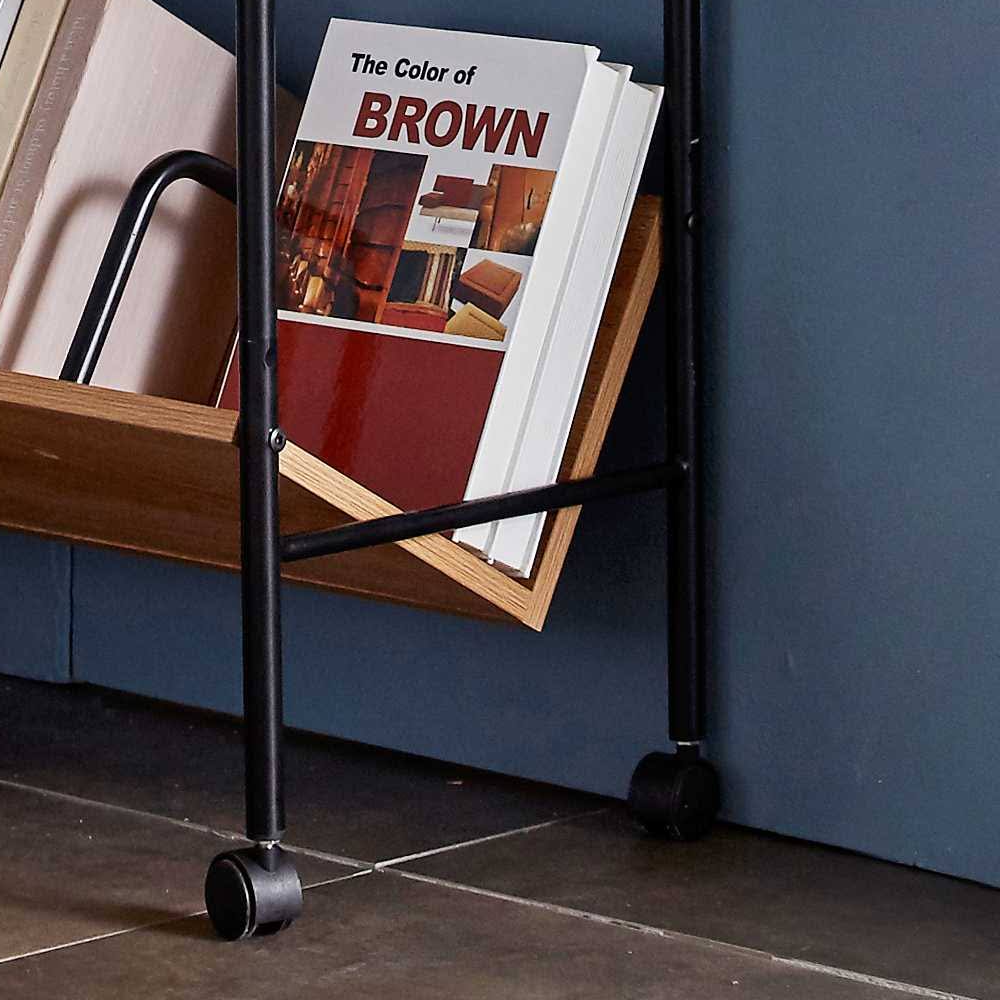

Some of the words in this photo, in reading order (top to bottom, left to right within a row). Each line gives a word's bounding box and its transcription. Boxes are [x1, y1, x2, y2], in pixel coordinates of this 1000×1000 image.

[351, 52, 388, 76] The
[394, 57, 449, 82] Color
[453, 65, 478, 85] of
[352, 91, 550, 158] BROWN
